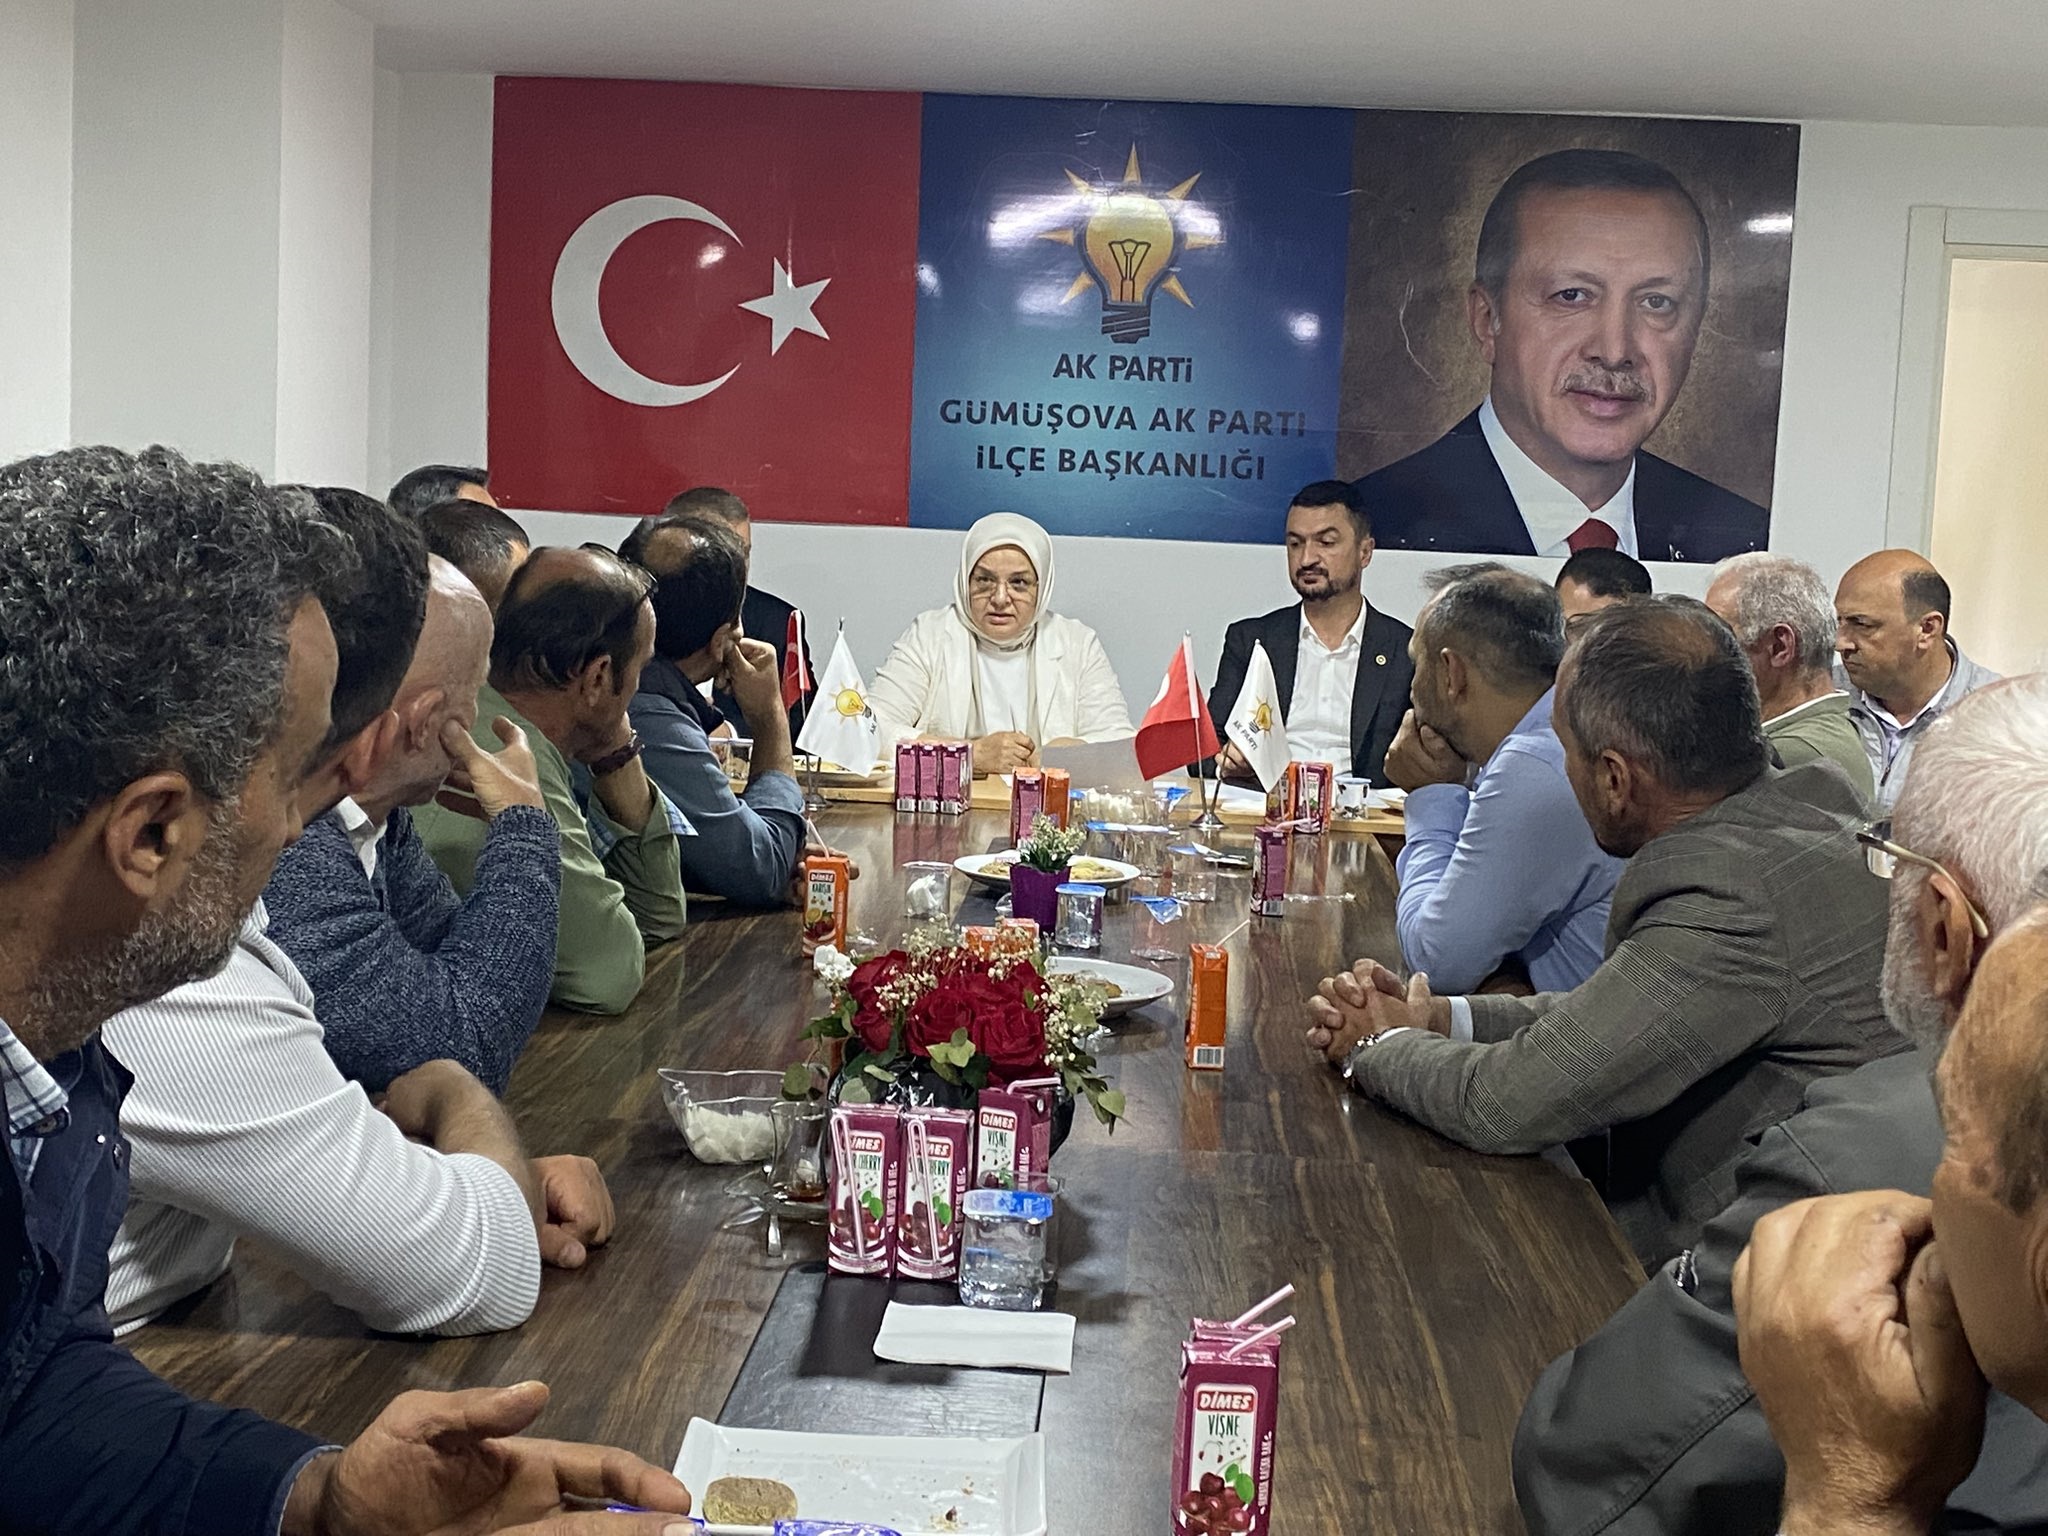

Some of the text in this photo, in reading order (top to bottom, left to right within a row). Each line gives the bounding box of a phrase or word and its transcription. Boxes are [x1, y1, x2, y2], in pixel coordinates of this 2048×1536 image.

[1053, 353, 1192, 383] AK PARTİ
[940, 400, 1137, 434] GÜMÜŞOVA
[1148, 407, 1196, 432] AK
[976, 445, 1264, 481] İLÇE BAŞKANLIĞI
[1208, 1413, 1240, 1438] VİŞNE
